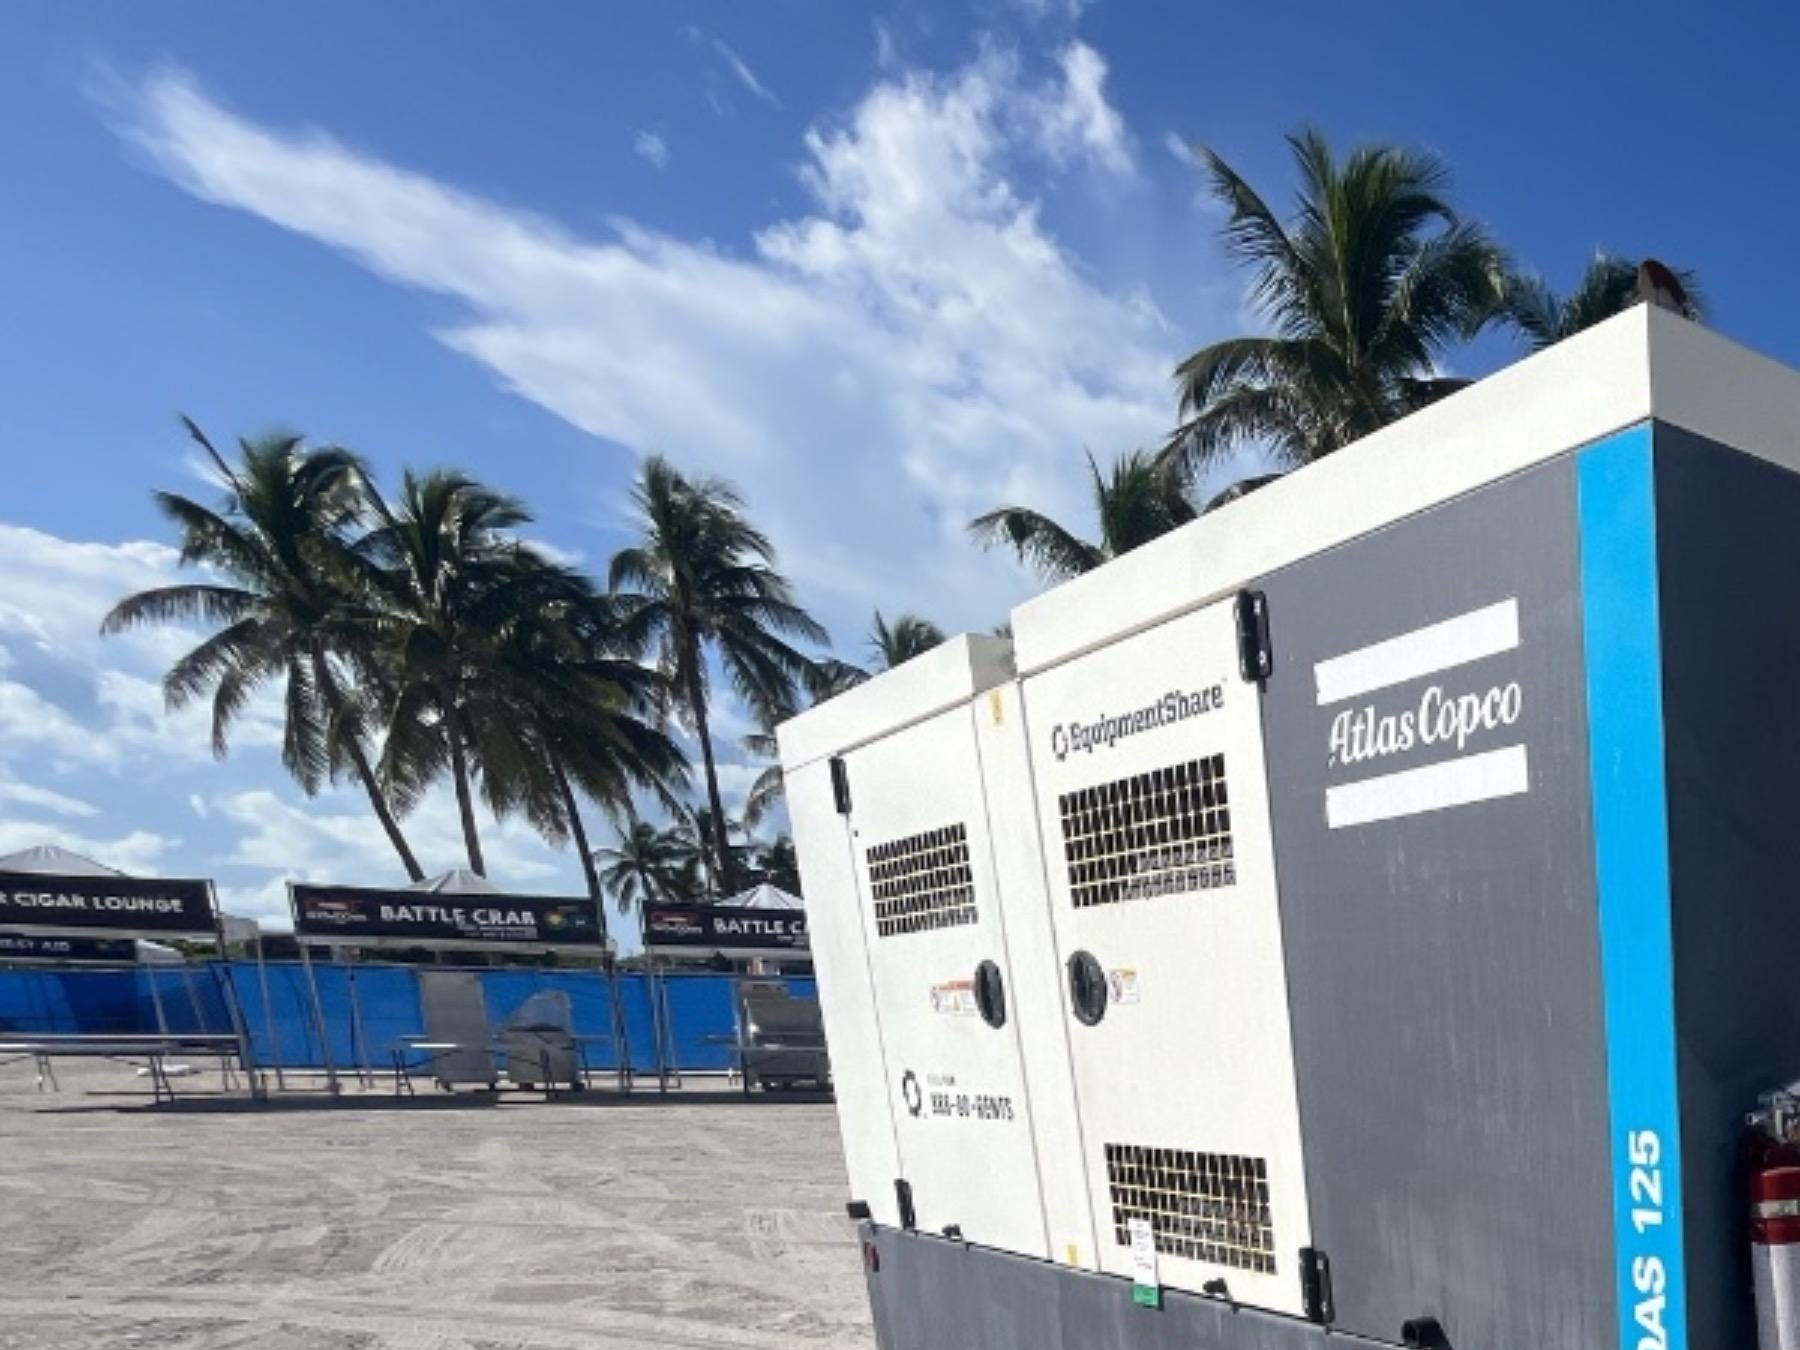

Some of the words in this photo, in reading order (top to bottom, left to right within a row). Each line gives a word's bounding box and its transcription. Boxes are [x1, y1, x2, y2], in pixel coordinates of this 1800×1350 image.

[1068, 681, 1226, 754] EquipmentShare
[1328, 704, 1414, 768] Atlas
[1419, 682, 1522, 751] Copco
[93, 896, 183, 914] LOUNGE
[379, 904, 466, 925] BATTLE
[713, 917, 784, 934] BATTLE
[1629, 1129, 1663, 1234] 125
